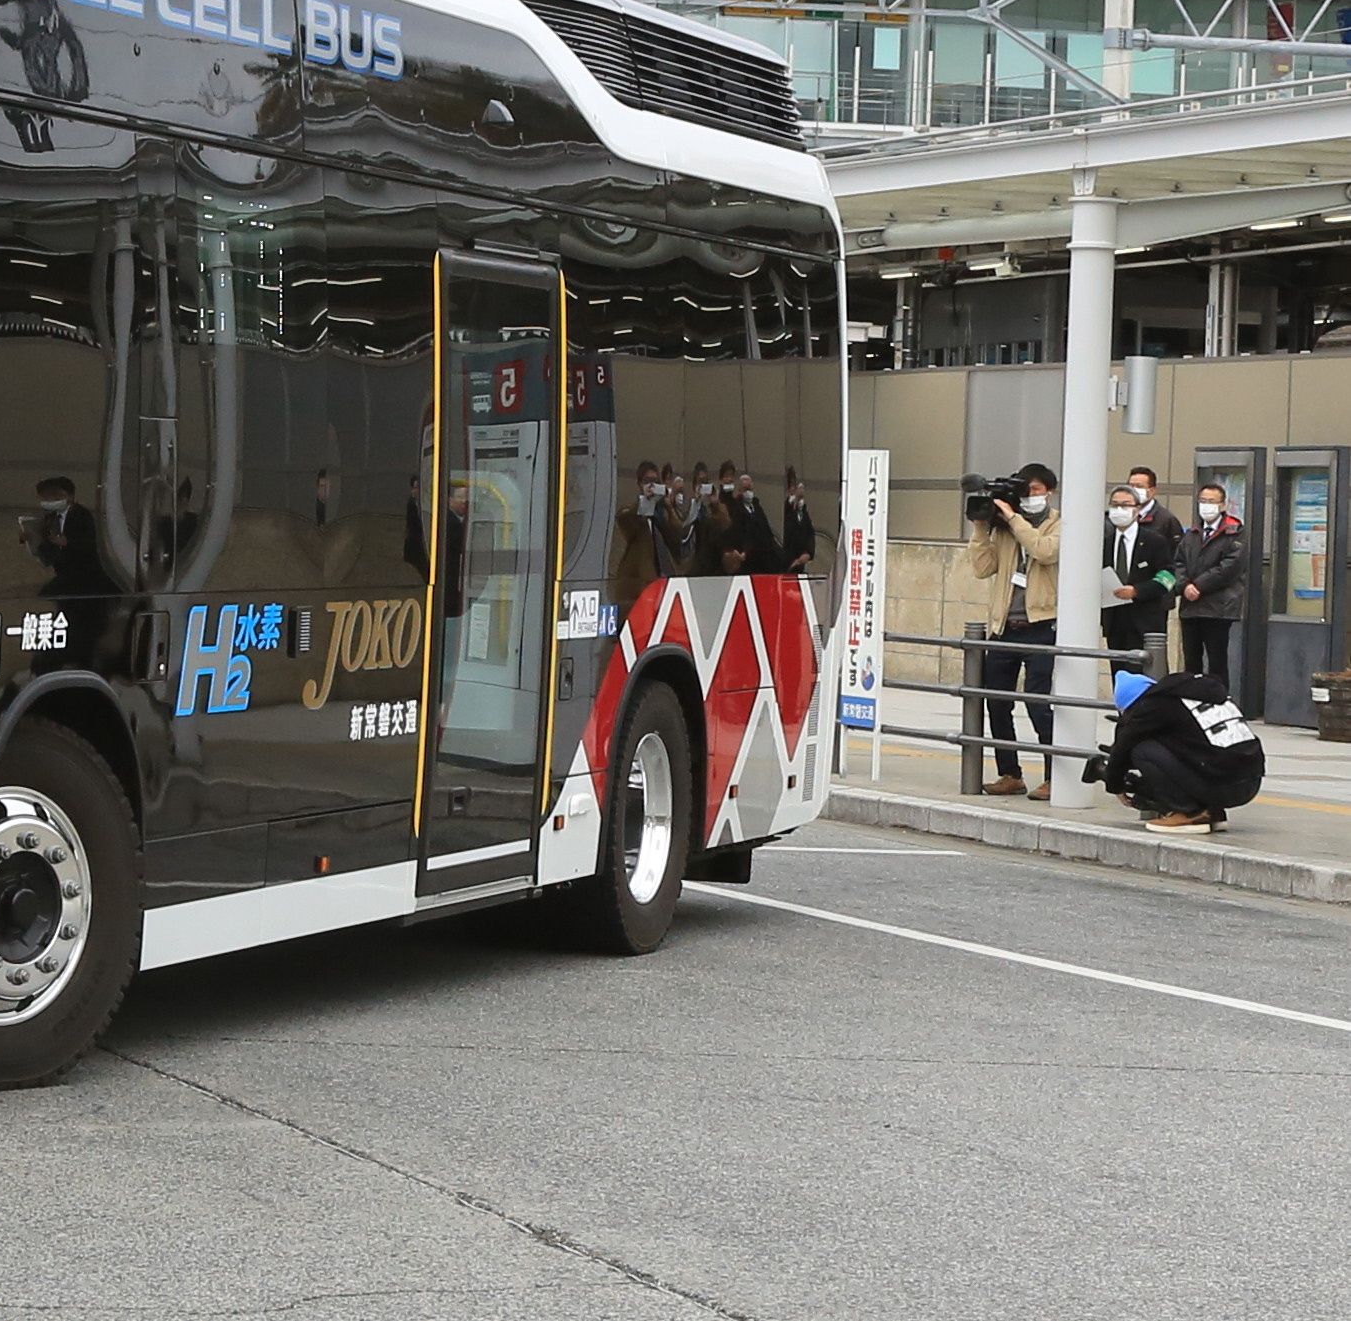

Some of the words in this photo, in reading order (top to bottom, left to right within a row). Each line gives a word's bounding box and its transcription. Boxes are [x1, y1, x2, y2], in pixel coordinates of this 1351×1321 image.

[864, 456, 878, 638] バスターミナル内は
[6, 611, 69, 651] 一般乗合
[234, 603, 284, 652] 水素
[580, 596, 596, 618] 入口
[848, 529, 863, 687] 横断禁止です
[302, 598, 422, 710] JOKO
[349, 699, 419, 742] 新常磐交通
